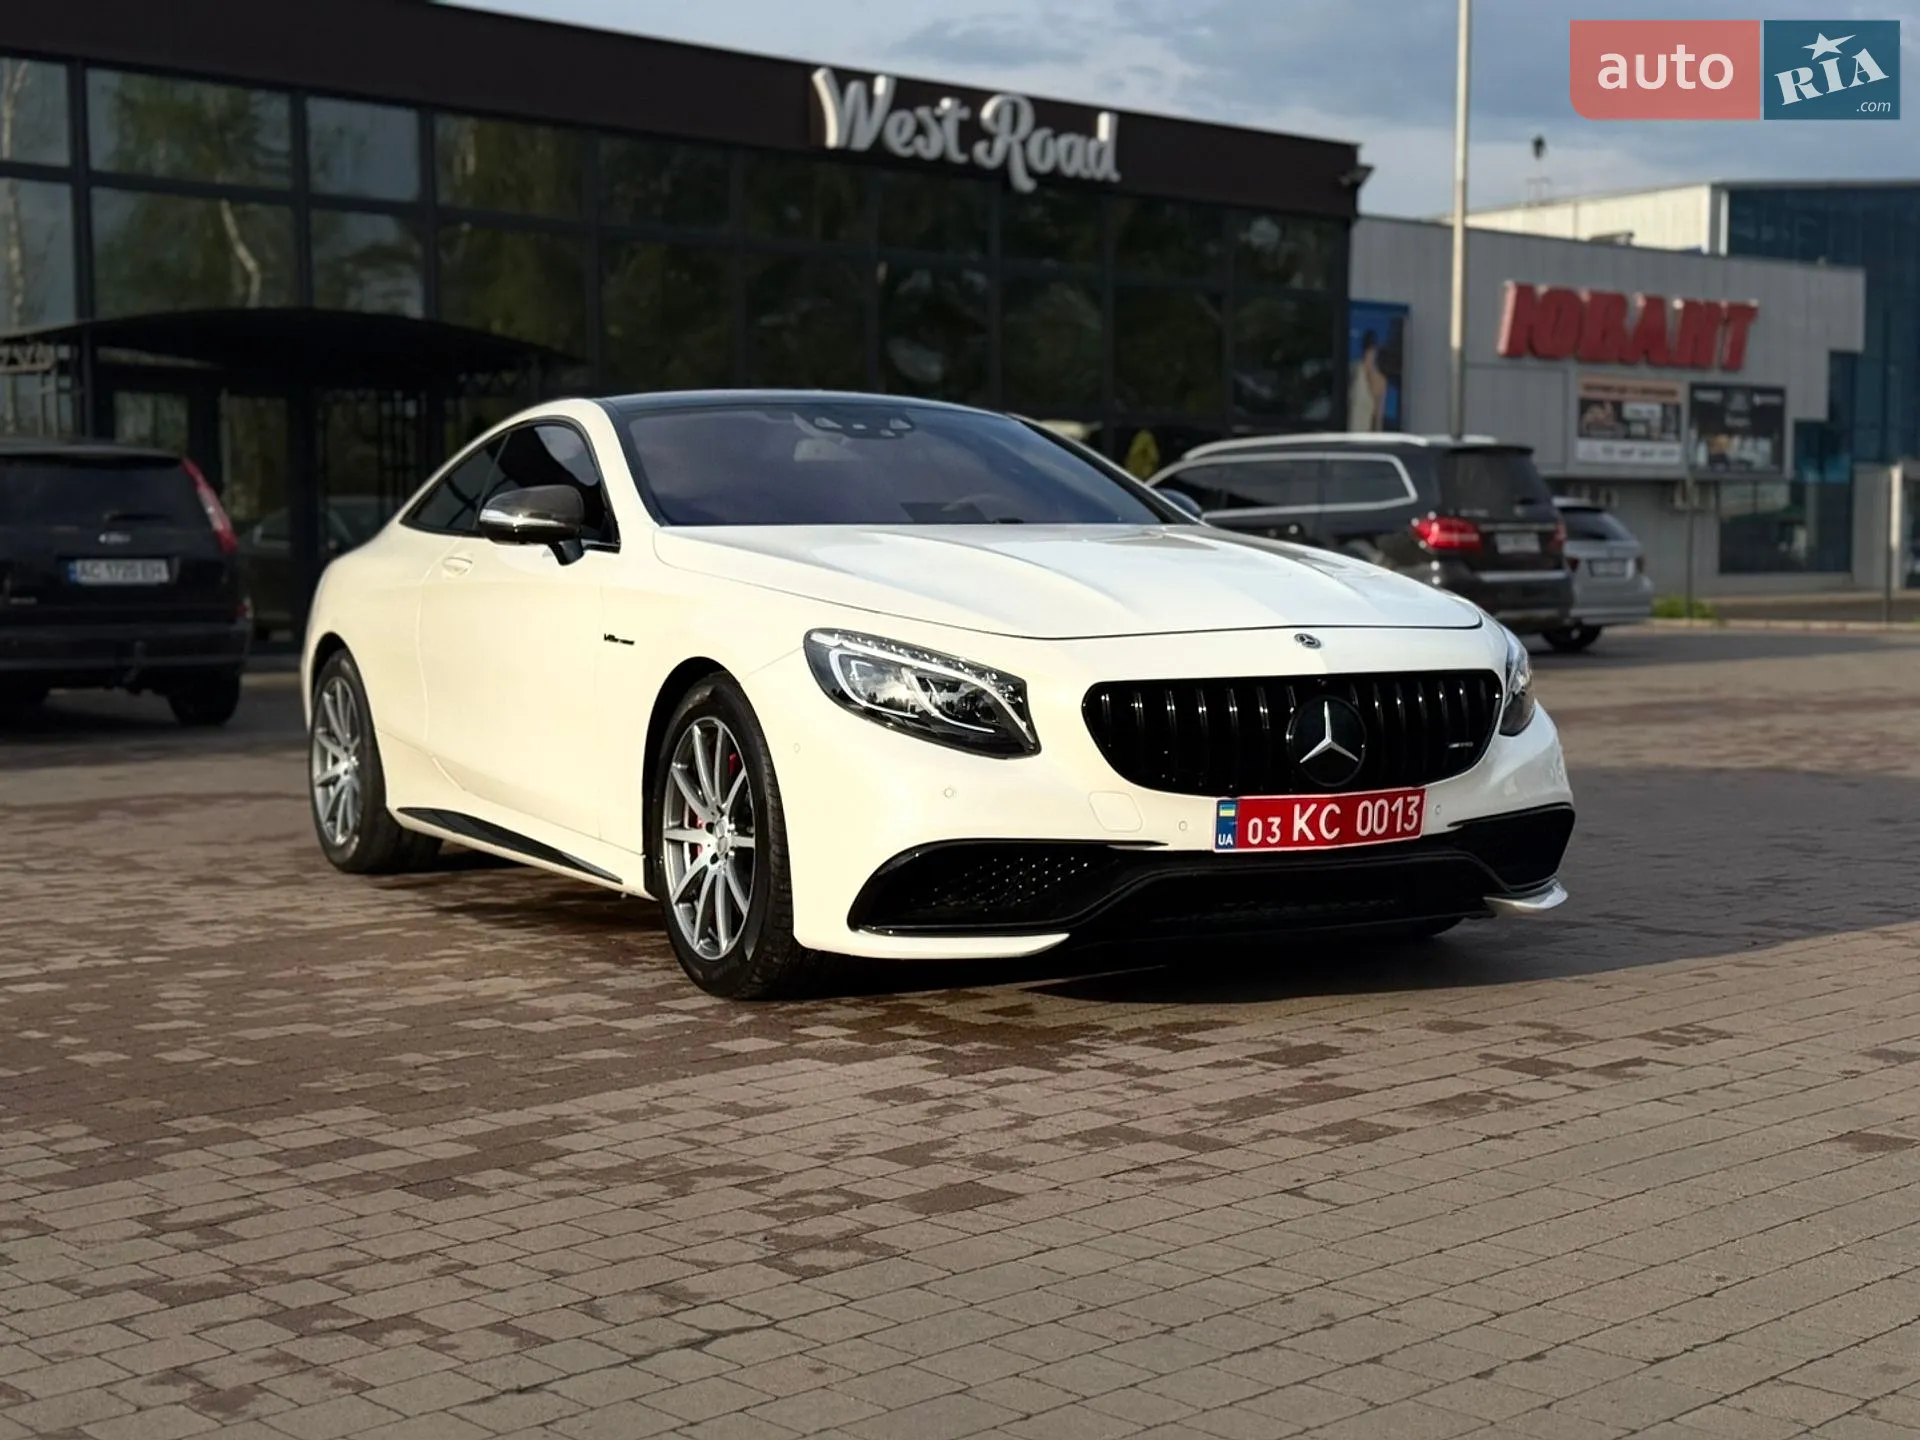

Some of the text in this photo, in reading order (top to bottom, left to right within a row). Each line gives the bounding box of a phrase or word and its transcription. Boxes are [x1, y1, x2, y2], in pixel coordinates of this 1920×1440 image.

[811, 66, 1122, 194] West Road
[1218, 834, 1234, 846] UA
[1247, 795, 1421, 845] 03 KC 0013
